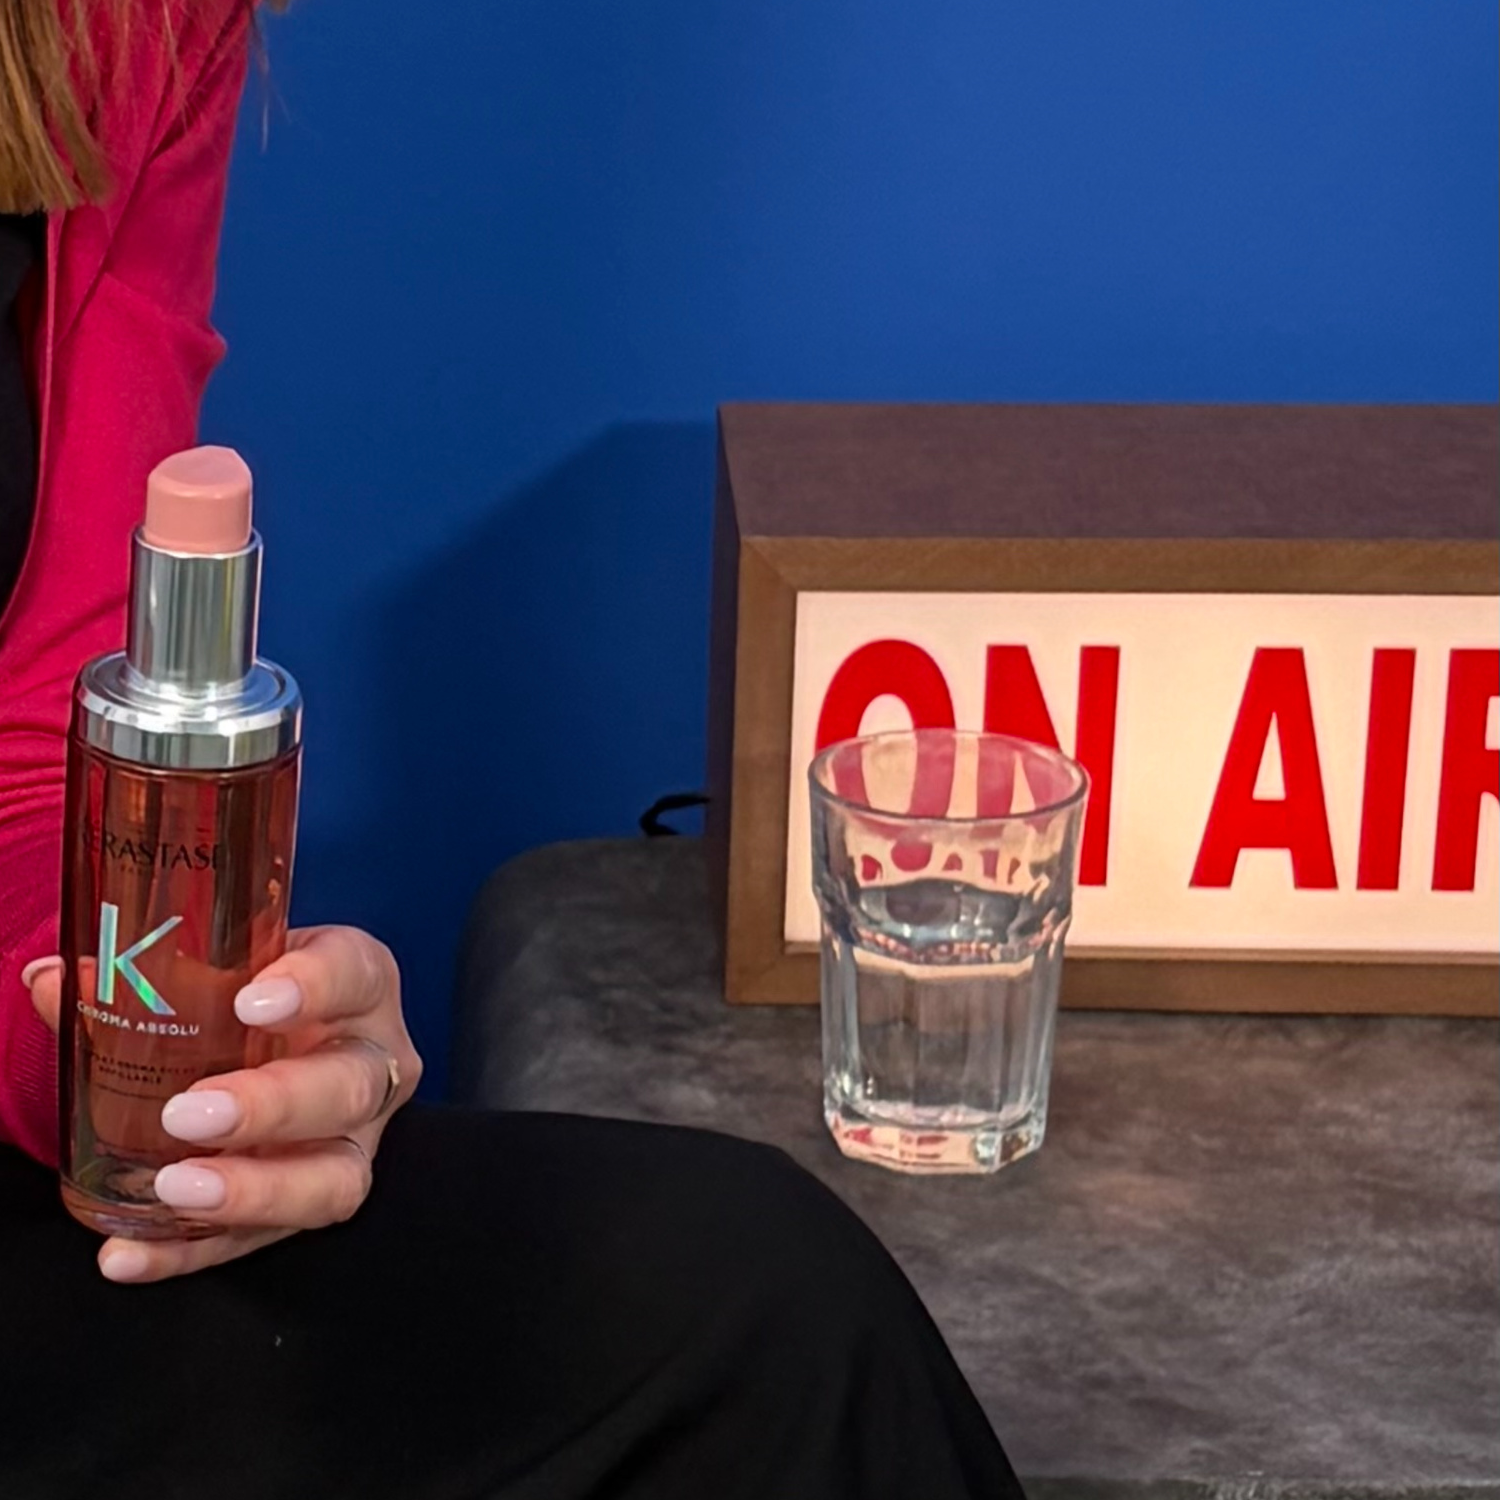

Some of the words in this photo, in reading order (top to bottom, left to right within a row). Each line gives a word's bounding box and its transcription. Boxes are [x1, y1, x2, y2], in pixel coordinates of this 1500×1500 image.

[815, 638, 1121, 888] ON
[82, 825, 222, 871] RASTAS
[97, 901, 184, 1016] K
